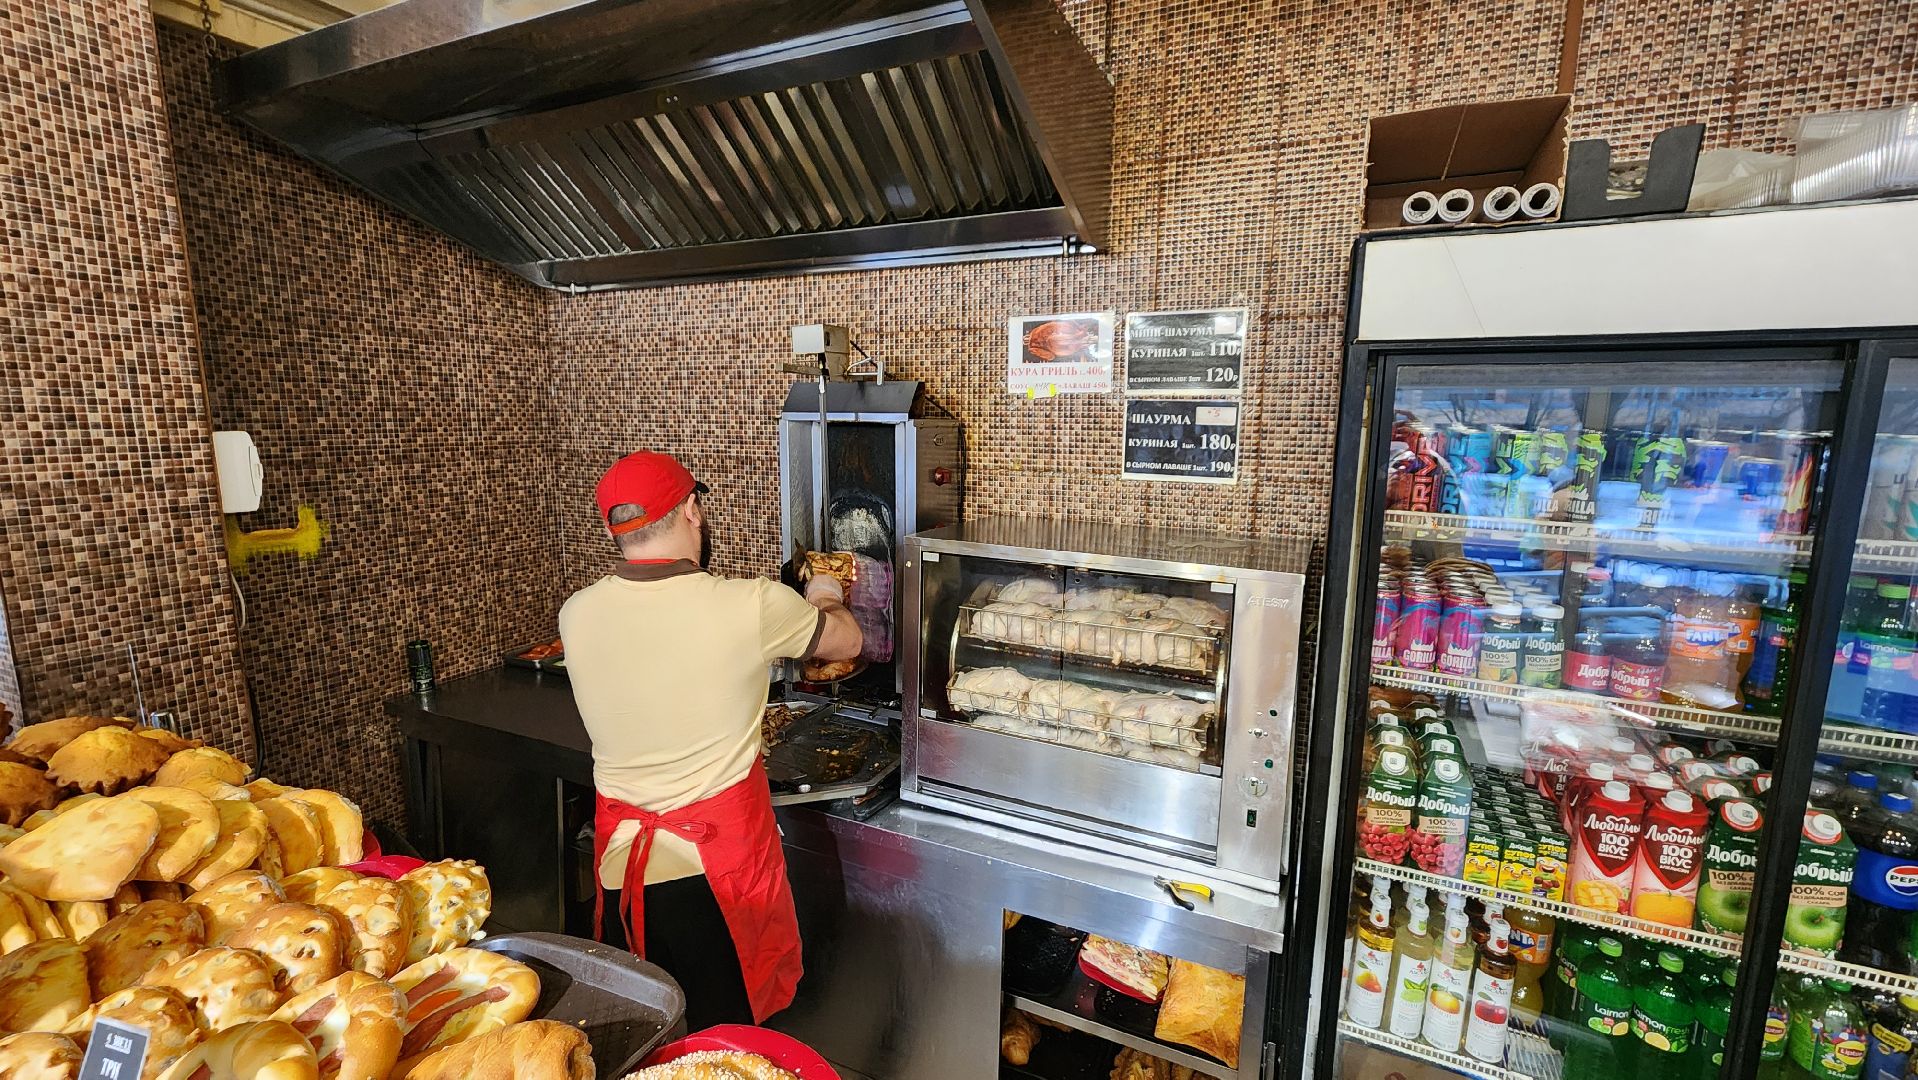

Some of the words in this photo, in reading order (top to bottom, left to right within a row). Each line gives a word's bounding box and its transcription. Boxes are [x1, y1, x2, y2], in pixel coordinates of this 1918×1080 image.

[1131, 348, 1187, 358] КУРИНАЯ
[1010, 367, 1038, 376] КУРА
[1041, 367, 1077, 376] ГРИЛЬ
[1132, 413, 1191, 425] ШАУРМА
[1128, 438, 1178, 448] КУРИНАЯ
[1132, 461, 1161, 470] СЫРНОМ
[1162, 463, 1191, 471] ЛАВАШЕ
[1525, 635, 1565, 653] Добрый
[1611, 667, 1650, 687] обрый
[1615, 684, 1632, 693] cola
[1366, 786, 1416, 807] Добрый
[1418, 794, 1470, 816] Добрый
[1376, 809, 1402, 818] 100%
[1428, 818, 1456, 827] 100%
[1598, 843, 1629, 857] ВКУС
[1660, 855, 1692, 869] ВКУС
[1711, 872, 1747, 881] 100%
[1793, 862, 1854, 882] обрый
[1793, 886, 1825, 896] 00%
[1840, 1048, 1863, 1057] Lipton
